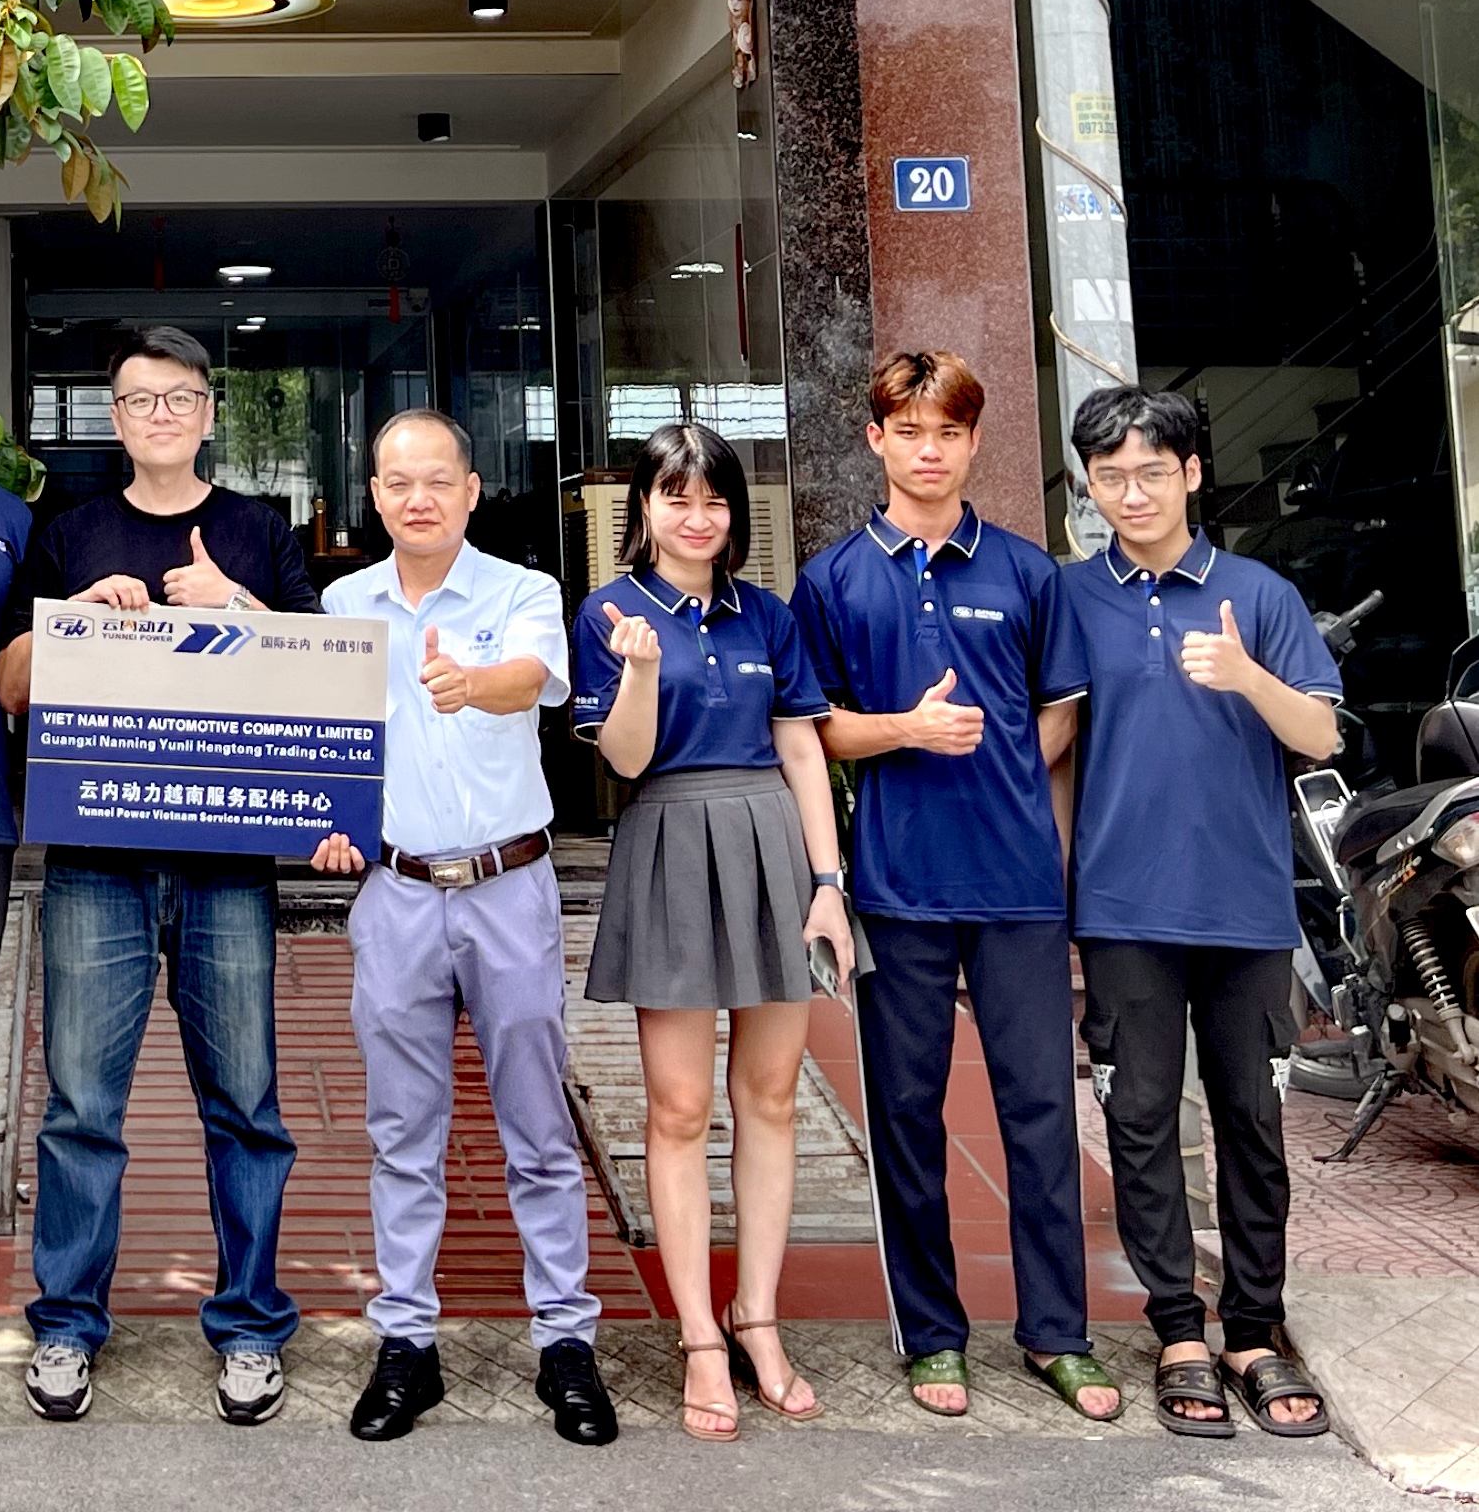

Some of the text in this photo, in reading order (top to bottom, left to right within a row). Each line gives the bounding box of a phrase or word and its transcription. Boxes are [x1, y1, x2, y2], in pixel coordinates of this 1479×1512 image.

[909, 167, 955, 202] 20
[101, 632, 173, 643] YUNNEI POWER
[102, 618, 174, 634] 云内动力
[261, 636, 374, 654] 国际云内 价值引领
[42, 712, 374, 741] VIET NAM NO.1 AUTOMOTIVE COMPANY LIMITED
[40, 732, 97, 749] Guangxi
[99, 735, 157, 752] Nanning
[159, 738, 194, 752] Yunli
[196, 740, 263, 757] Hengtong
[265, 743, 317, 760] Trading
[348, 748, 375, 762] Ltd.
[79, 780, 333, 812] 云内动力越南服务配件中心
[116, 807, 151, 820] Power
[152, 809, 198, 822] Vietnam
[199, 811, 241, 824] Service
[242, 814, 263, 825] and
[264, 815, 294, 827] Parts
[295, 816, 334, 829] Center
